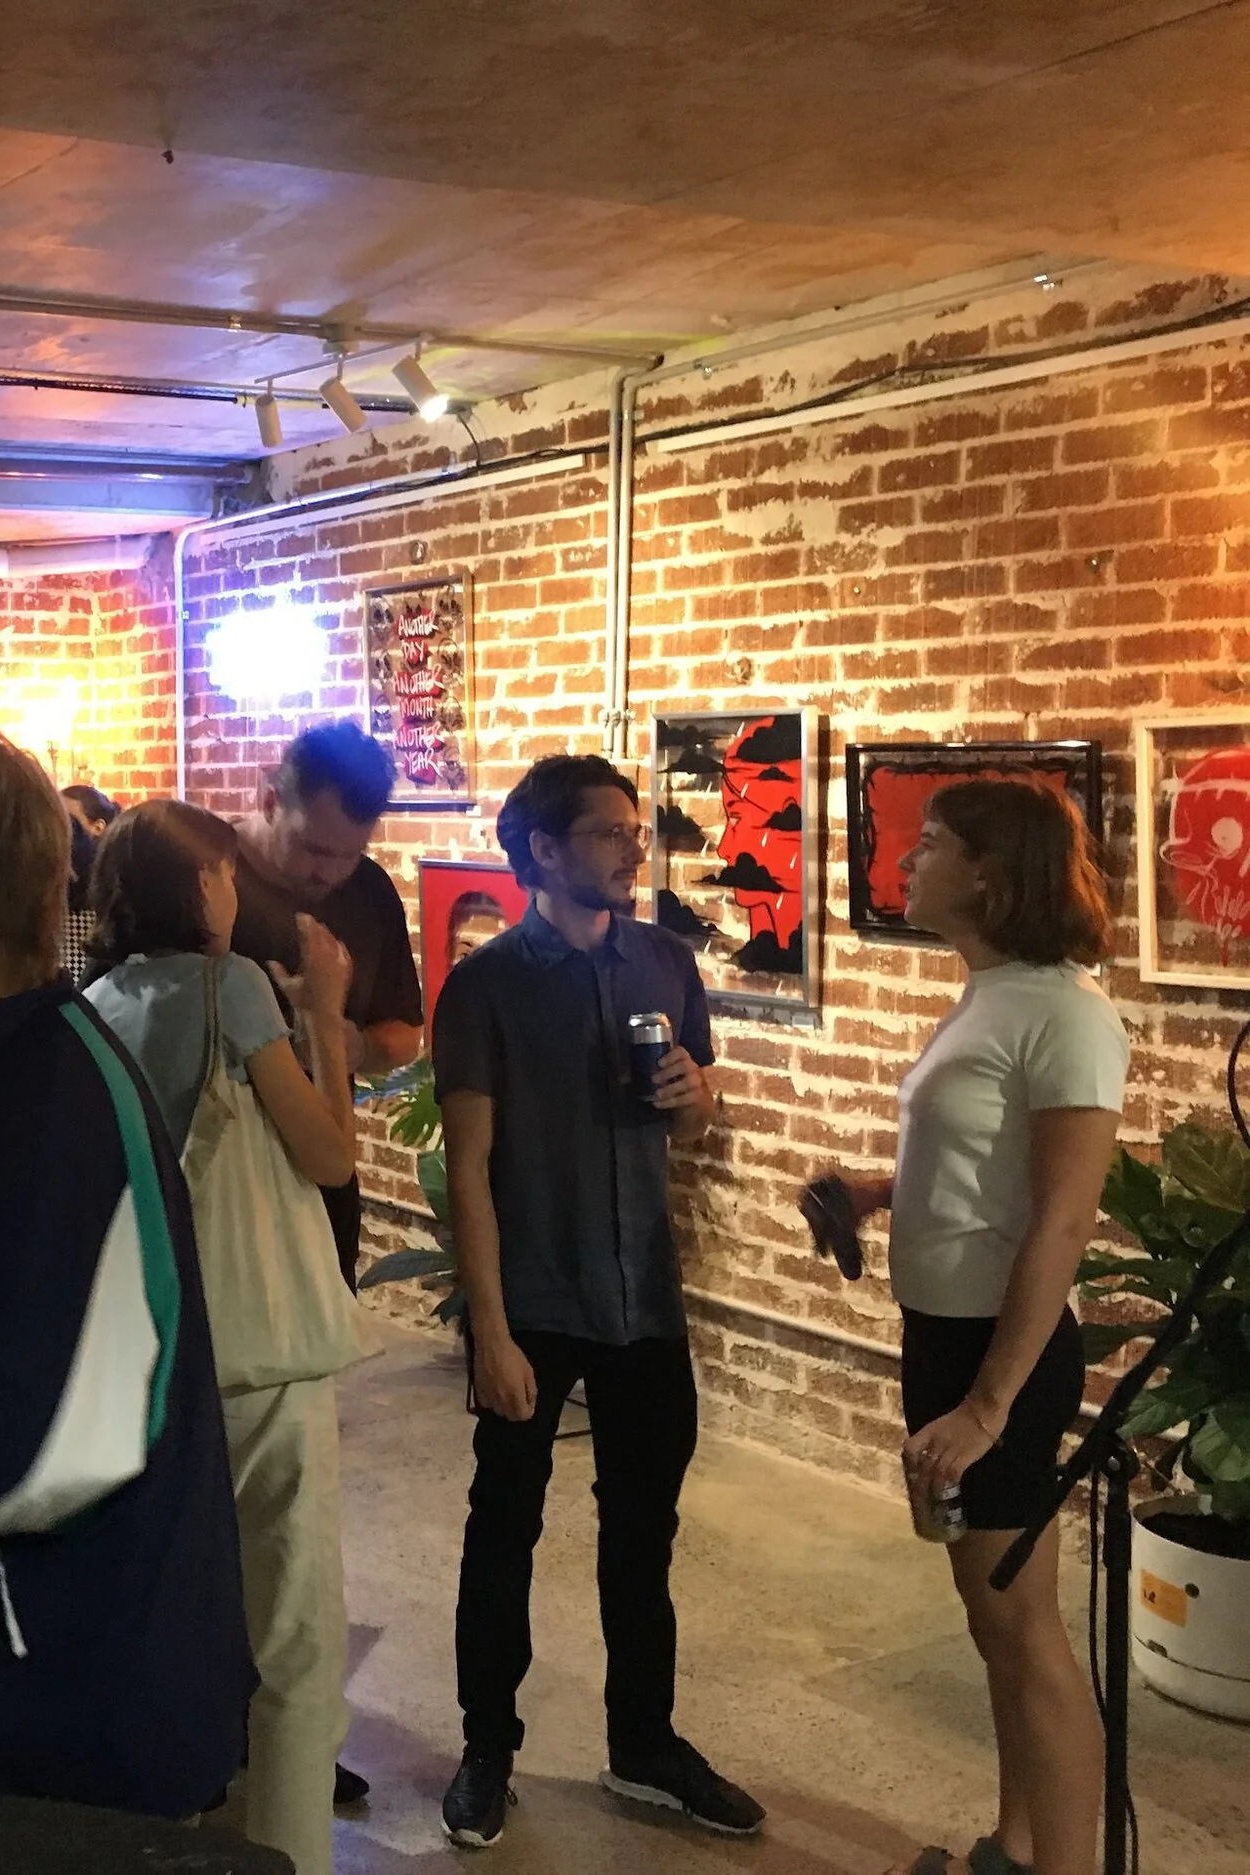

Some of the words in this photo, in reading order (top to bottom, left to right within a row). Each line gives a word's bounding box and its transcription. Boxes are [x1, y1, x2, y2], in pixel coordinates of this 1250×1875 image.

[398, 609, 440, 637] ANOTHER
[401, 640, 425, 662] DAY
[392, 664, 445, 695] ANOTHER
[398, 697, 435, 719] MONTH
[392, 721, 445, 750] ANOTHER
[404, 748, 443, 778] YEAR
